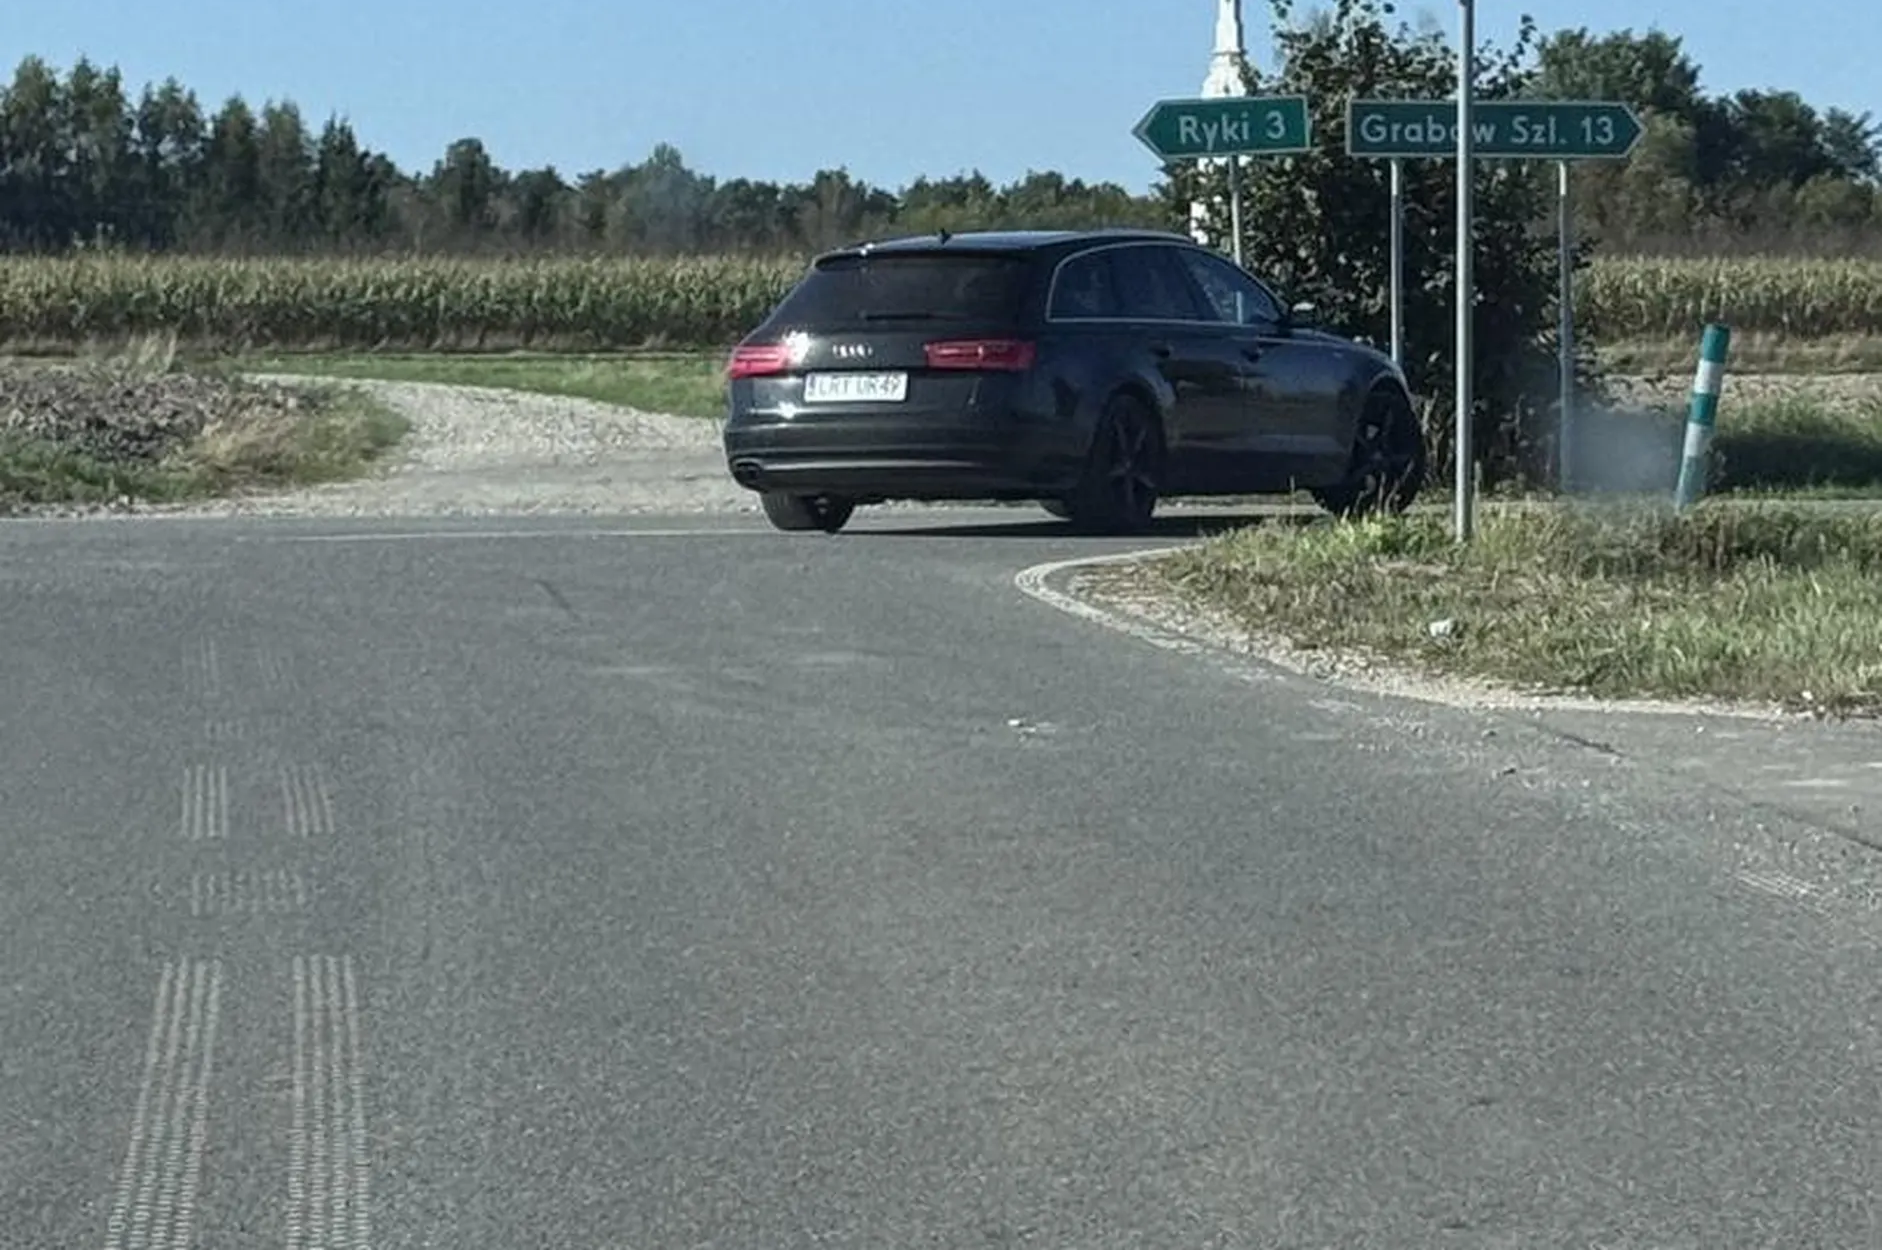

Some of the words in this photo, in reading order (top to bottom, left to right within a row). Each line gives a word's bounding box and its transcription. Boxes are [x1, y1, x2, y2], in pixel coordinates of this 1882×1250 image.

[1179, 111, 1250, 152] Ryki
[1265, 109, 1286, 140] 3
[1510, 114, 1568, 145] Szl.
[1581, 115, 1615, 145] 13
